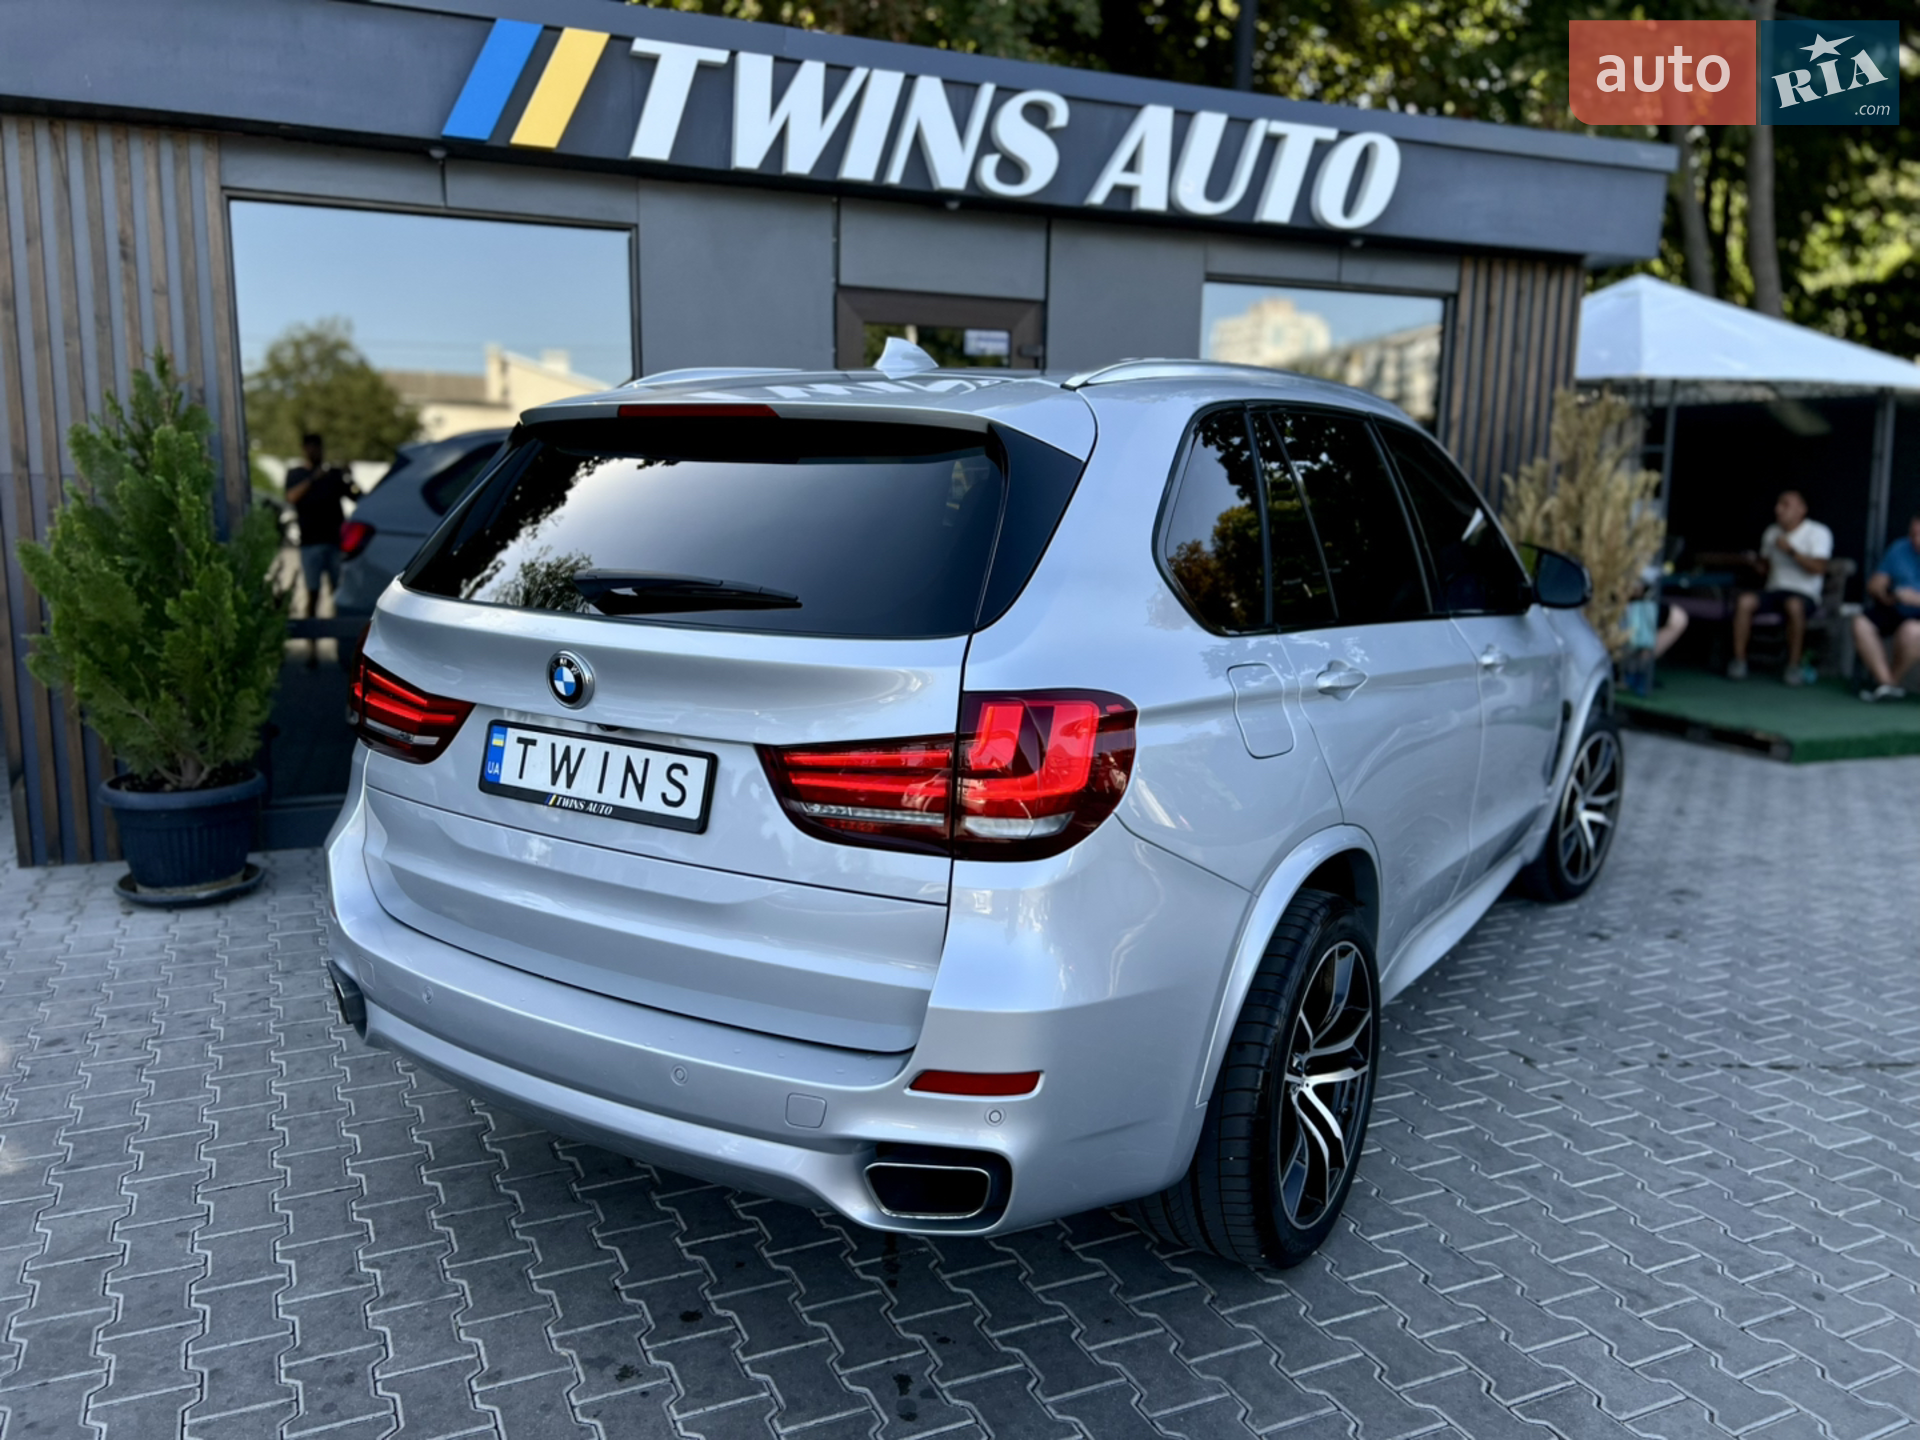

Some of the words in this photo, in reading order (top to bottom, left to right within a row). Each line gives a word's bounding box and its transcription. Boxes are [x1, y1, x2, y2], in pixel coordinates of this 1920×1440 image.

[630, 37, 1069, 198] TWINS
[1087, 103, 1402, 231] AUTO
[487, 761, 500, 775] UA
[516, 736, 689, 808] TWINS
[555, 796, 586, 811] TWINS
[586, 802, 613, 816] AUTO
